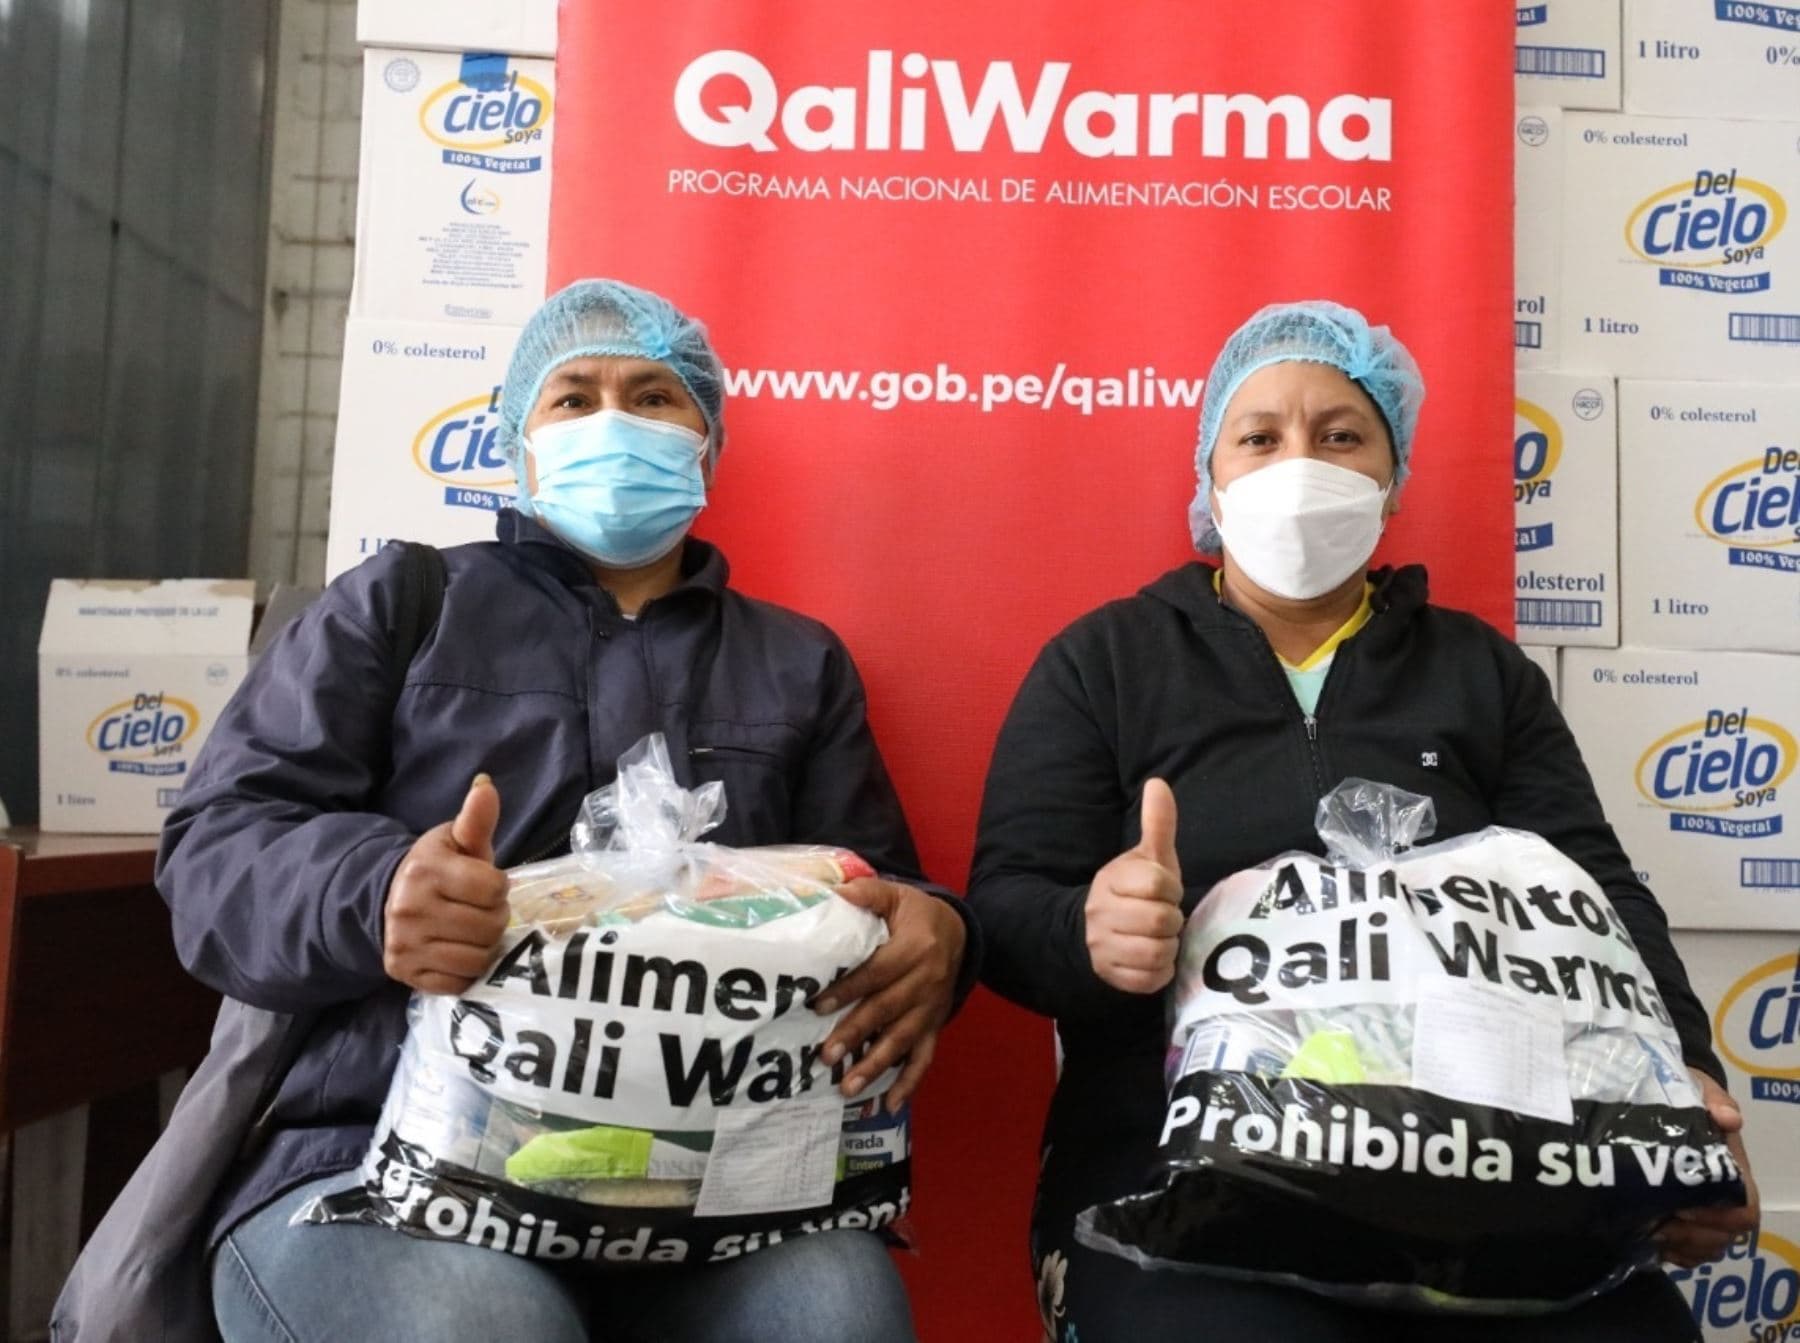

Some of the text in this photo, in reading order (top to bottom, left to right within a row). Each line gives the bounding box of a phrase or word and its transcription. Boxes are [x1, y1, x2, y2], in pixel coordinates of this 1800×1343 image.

[1727, 4, 1770, 23] 100%
[1638, 41, 1700, 59] 1 litro
[1766, 46, 1800, 65] 0%
[443, 91, 542, 134] Cielo
[674, 49, 1392, 162] QaliWarma
[504, 129, 542, 144] Soya
[1583, 130, 1688, 147] 0% colesterol
[450, 153, 531, 171] 100% Vegetal
[667, 169, 1392, 212] PROGRAMA NACIONAL DE ALIMENTACIÓN ESCOLAR
[1693, 168, 1737, 197] Del
[1643, 197, 1767, 256] Cielo
[1722, 244, 1764, 265] Soya
[1670, 272, 1760, 292] 100% Vegetal
[1584, 317, 1640, 335] 1 litro
[372, 340, 487, 360] 0% colesterol
[1650, 406, 1757, 424] 0% colesterol
[456, 491, 494, 507] 100%
[1740, 552, 1776, 567] 100%
[1652, 599, 1709, 616] 1 litro
[1593, 668, 1699, 686] 0% colesterol
[134, 691, 164, 712] Del
[98, 712, 185, 752] Cielo
[1705, 707, 1748, 738] Del
[1653, 737, 1779, 800] Cielo
[1733, 787, 1777, 808] Soya
[1681, 816, 1772, 837] 100% Vegetal
[1202, 912, 1390, 1005] Qali
[486, 929, 850, 1021] Alimen
[450, 999, 626, 1100] Qali
[1158, 1095, 1513, 1183] Prohibida
[1536, 1141, 1616, 1187] su
[1669, 1256, 1798, 1329] ielo
